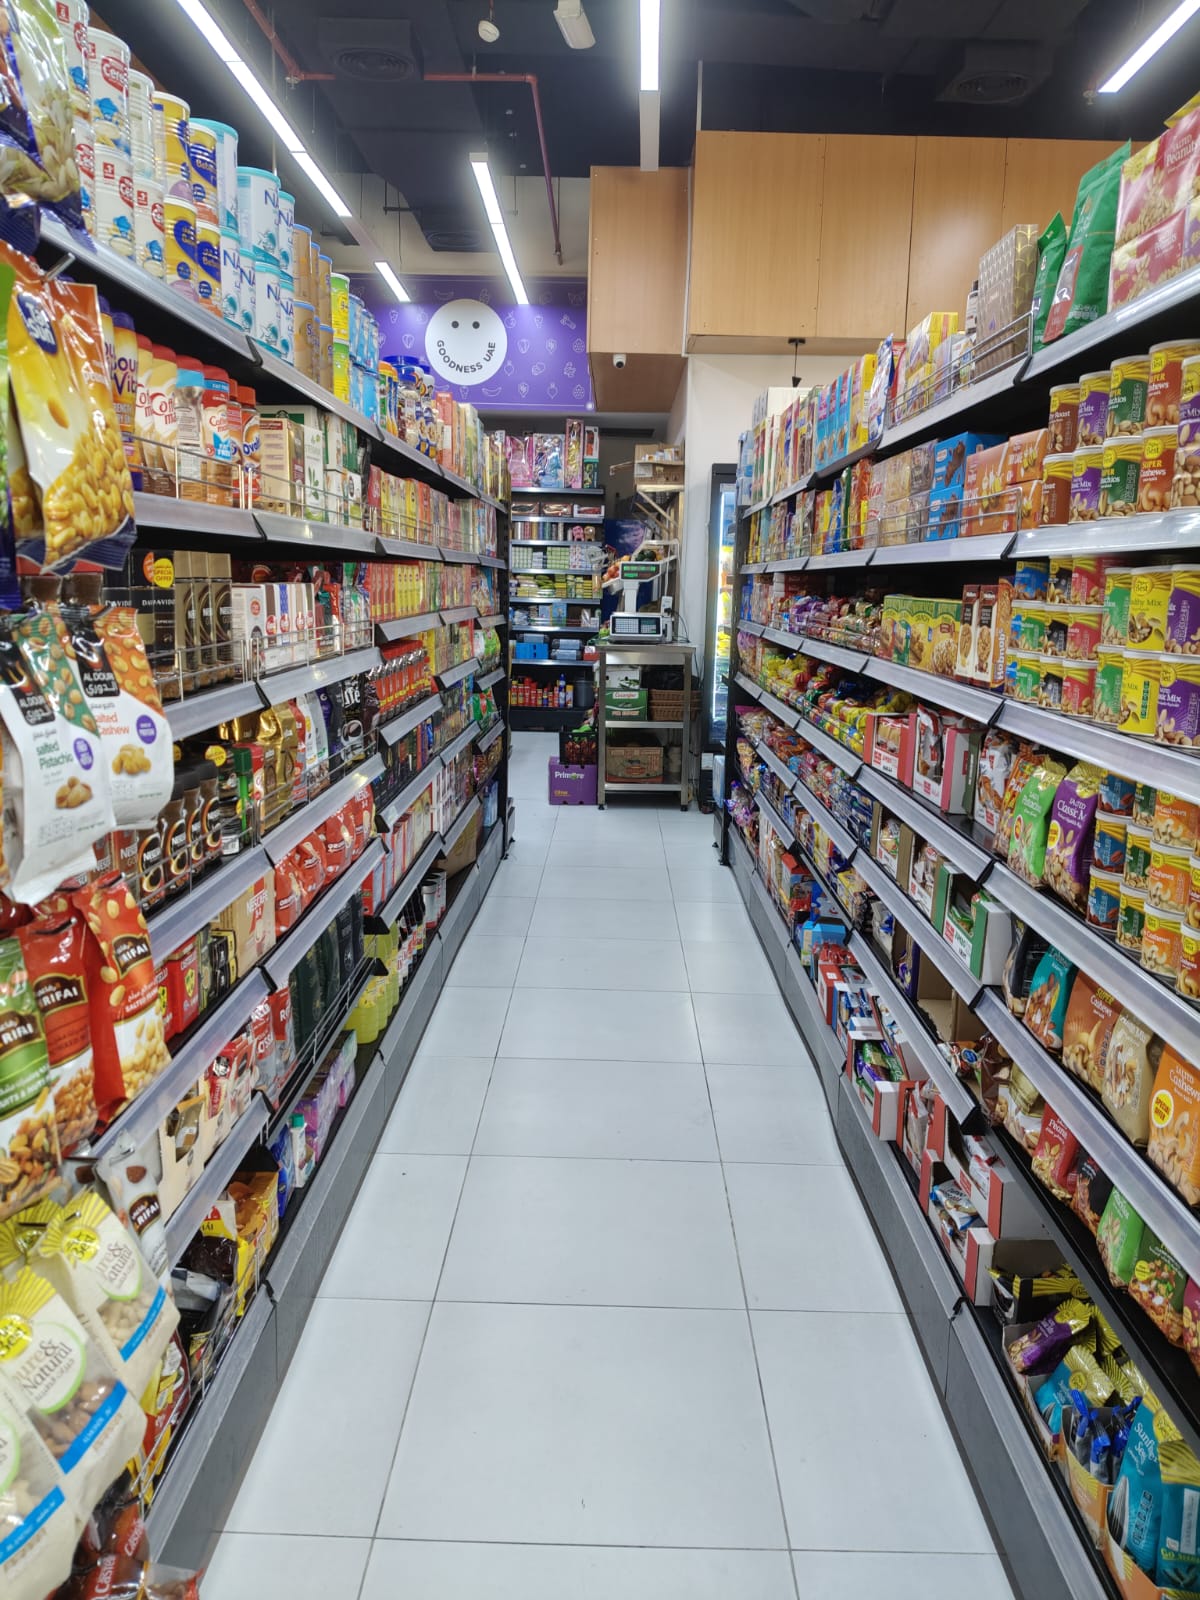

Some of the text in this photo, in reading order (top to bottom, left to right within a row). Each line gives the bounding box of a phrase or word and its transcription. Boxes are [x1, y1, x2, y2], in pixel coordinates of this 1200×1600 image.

[436, 339, 496, 374] GOODNESS UAE
[1057, 799, 1080, 818] Classic
[42, 986, 79, 1007] RIFAI
[1096, 987, 1115, 1005] SUPER
[136, 1203, 160, 1227] RIFAI
